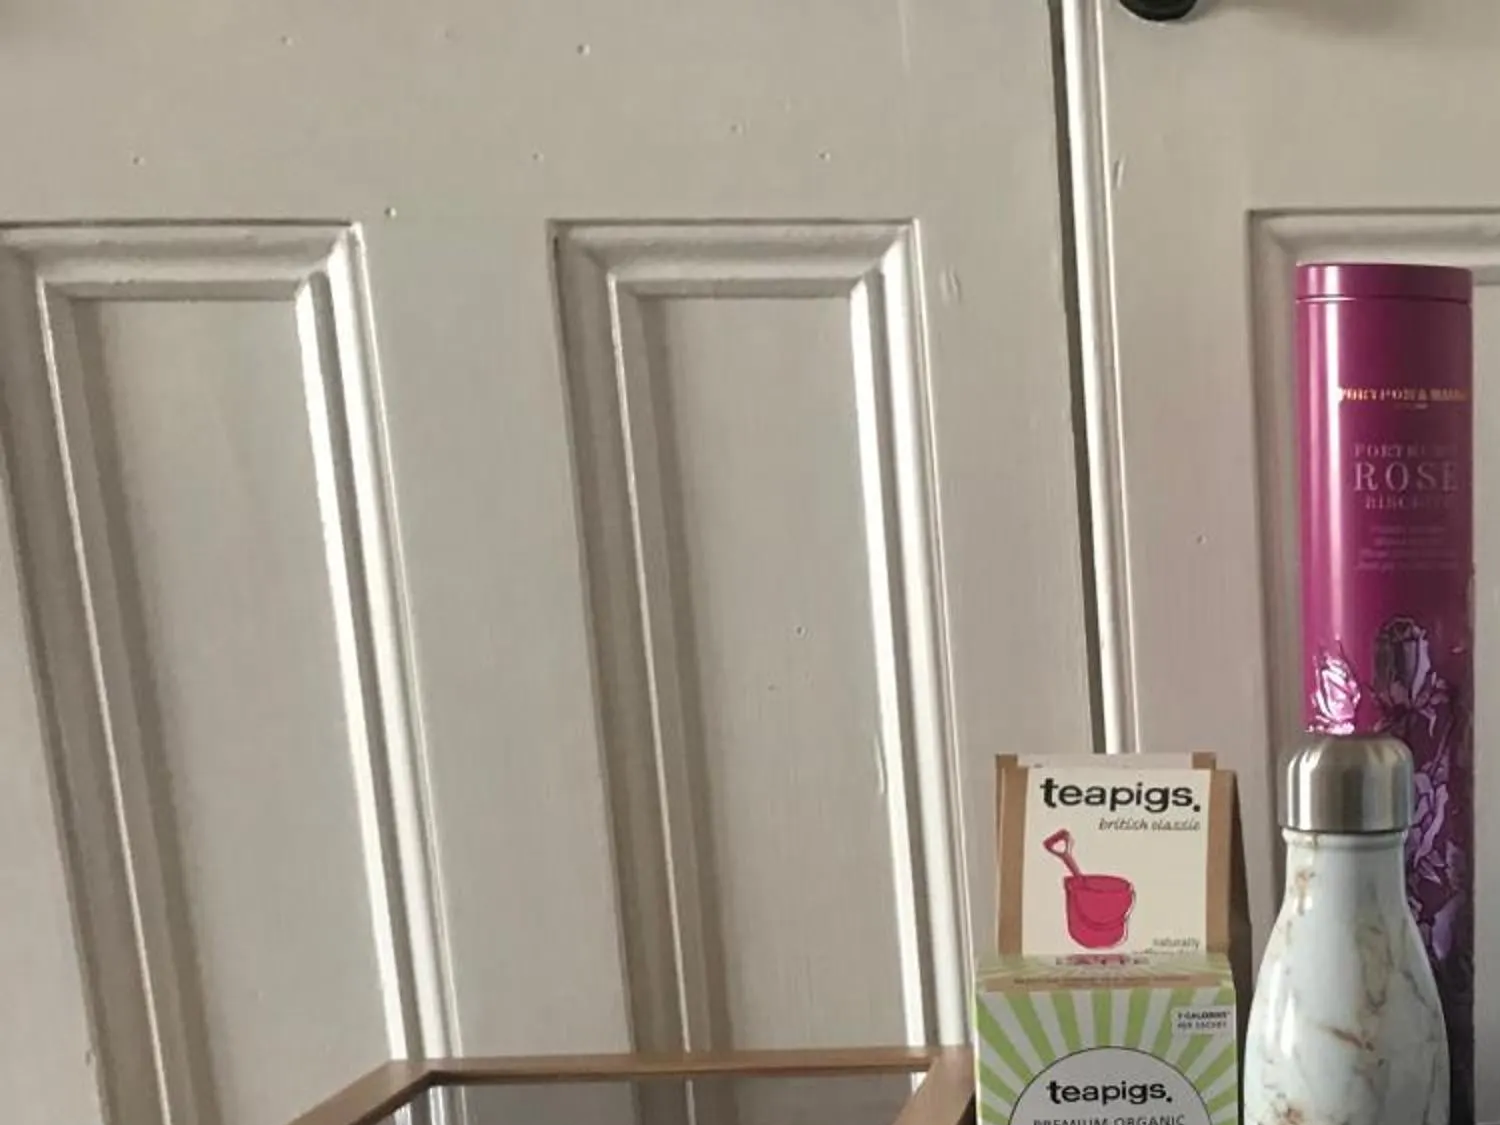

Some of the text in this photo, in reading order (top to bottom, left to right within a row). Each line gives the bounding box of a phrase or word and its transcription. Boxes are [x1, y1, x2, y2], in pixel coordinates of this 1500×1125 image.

[1354, 461, 1458, 492] ROSE
[1040, 778, 1201, 813] teapigs.
[1099, 817, 1148, 831] british
[1046, 1080, 1173, 1106] teapigs.
